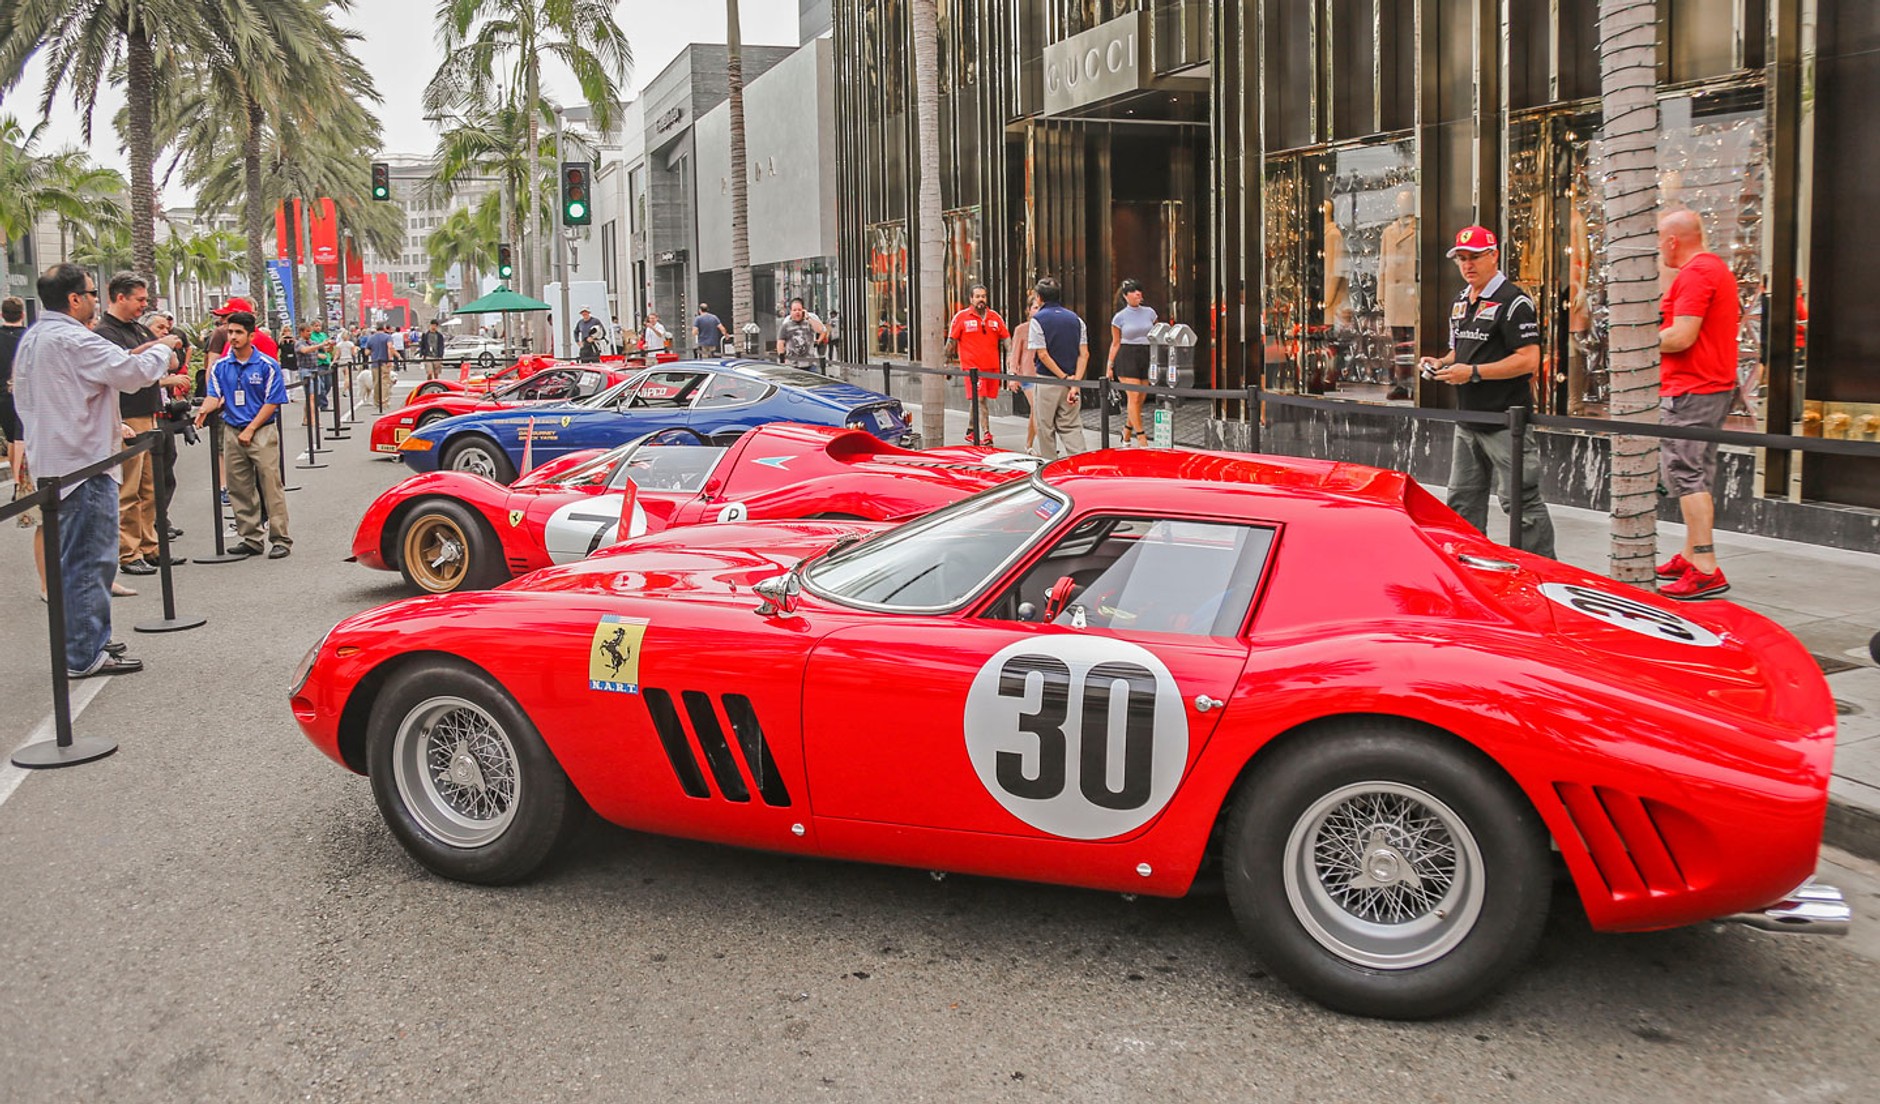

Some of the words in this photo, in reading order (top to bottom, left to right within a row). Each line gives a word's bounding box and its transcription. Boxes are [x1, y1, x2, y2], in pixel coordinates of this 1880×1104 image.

[1048, 34, 1134, 96] GUCCI
[566, 511, 620, 559] 7
[727, 508, 740, 522] P
[1563, 586, 1696, 641] 30
[996, 653, 1157, 811] 30
